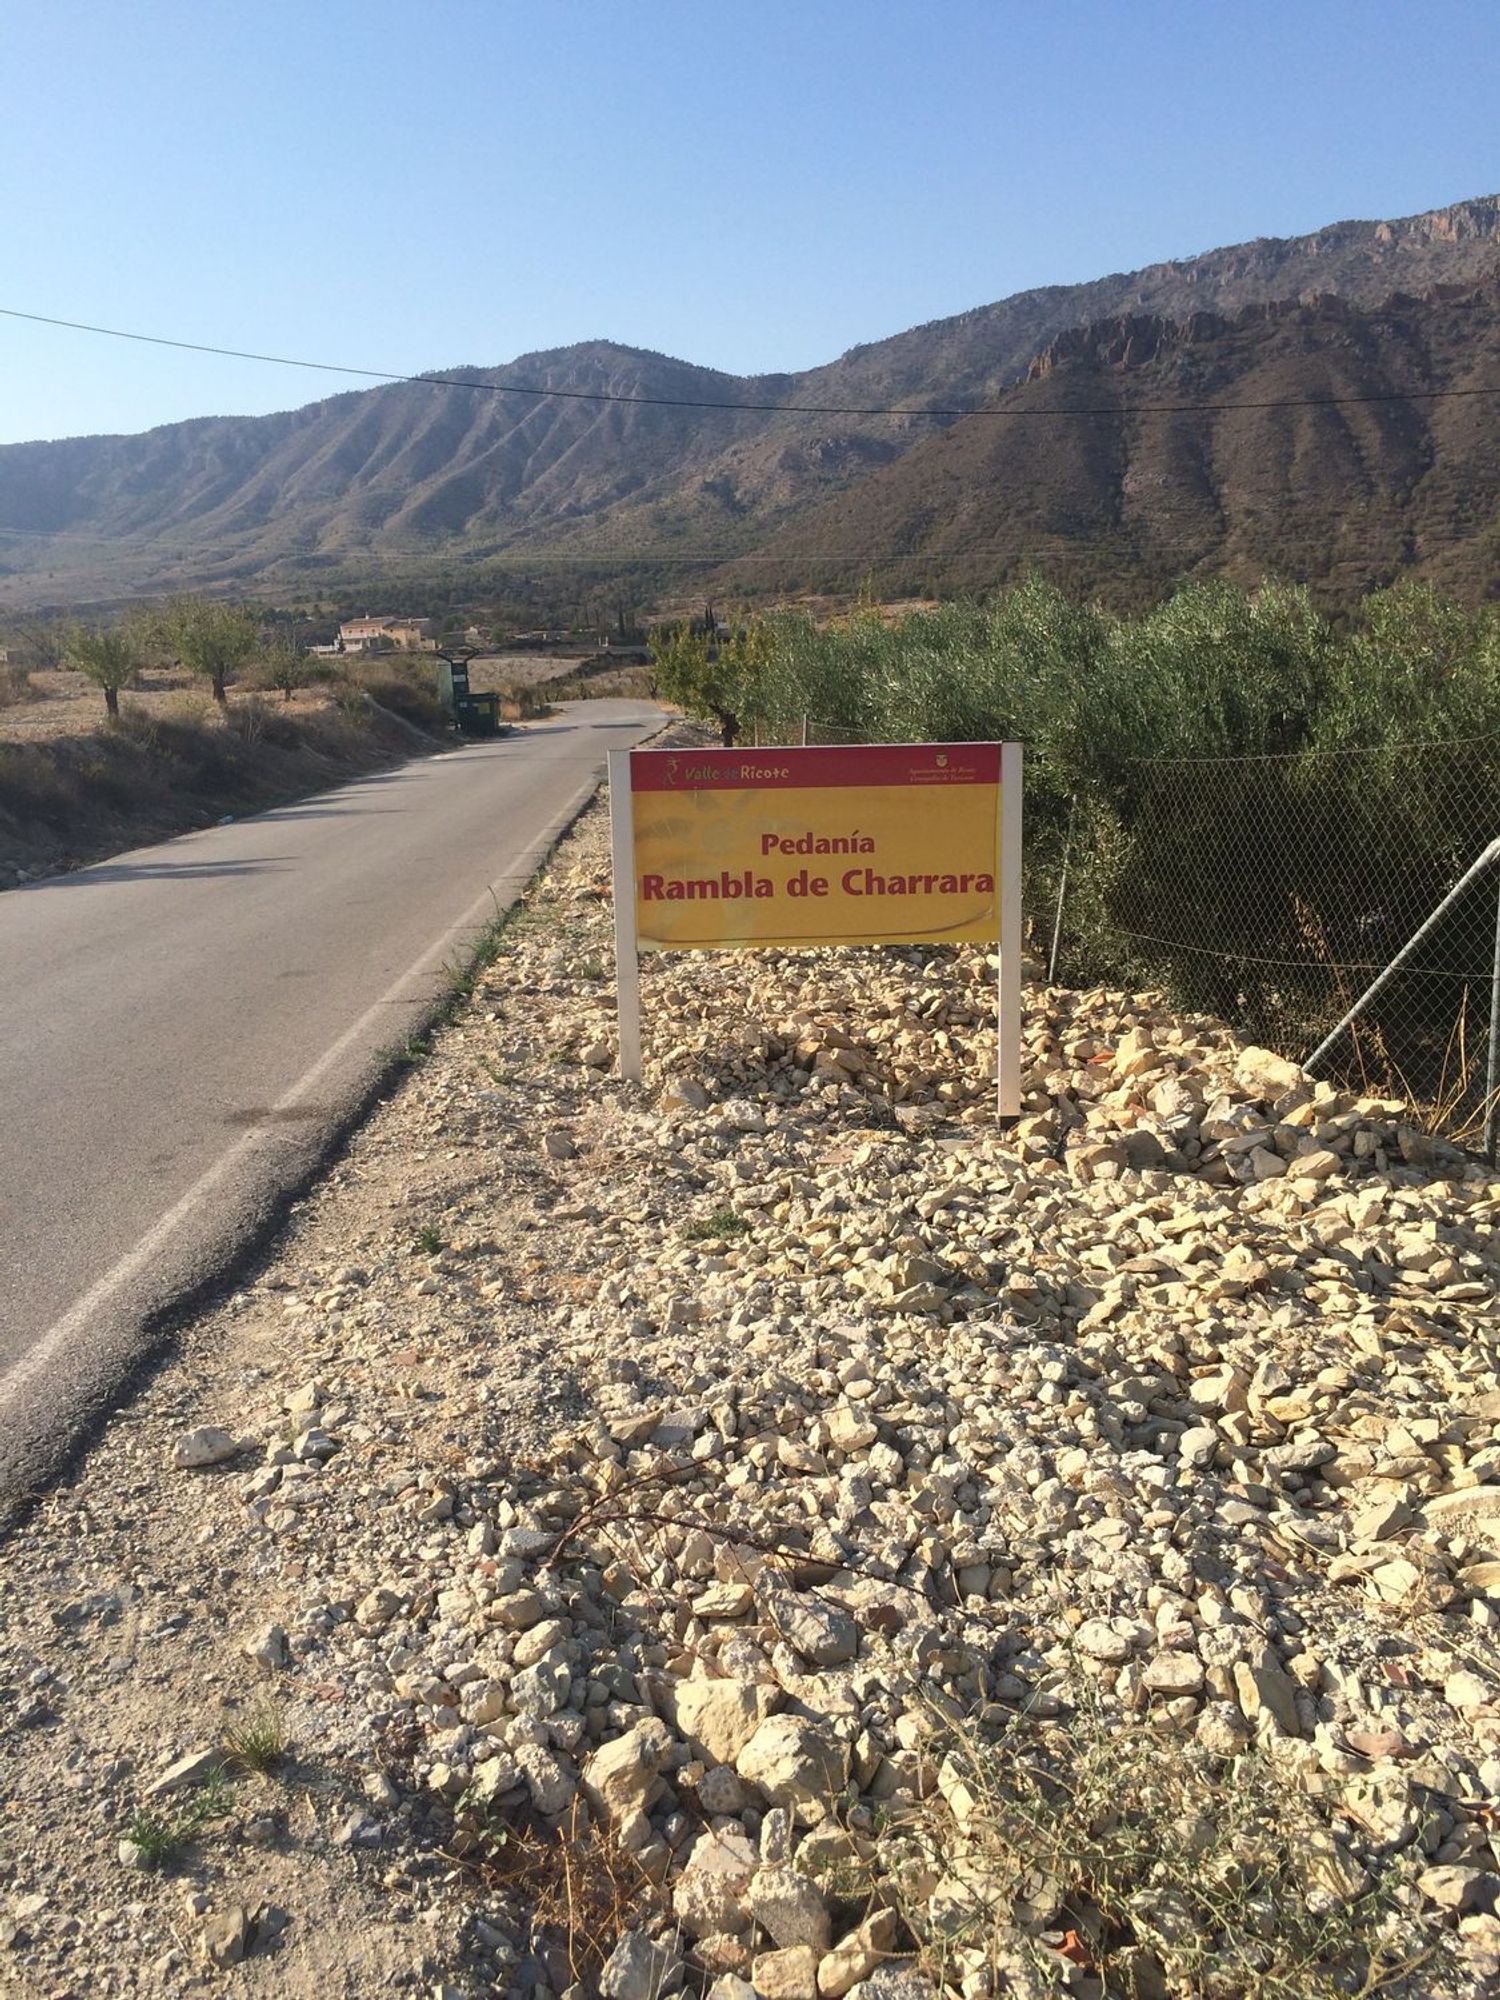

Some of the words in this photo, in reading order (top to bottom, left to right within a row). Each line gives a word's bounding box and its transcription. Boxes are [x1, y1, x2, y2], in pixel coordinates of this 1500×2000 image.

[684, 765, 720, 780] Valle
[740, 765, 790, 780] Ricote
[761, 830, 875, 856] Pedanía
[642, 871, 774, 901] Rambla
[786, 869, 829, 897] de
[841, 868, 995, 897] Charrara
